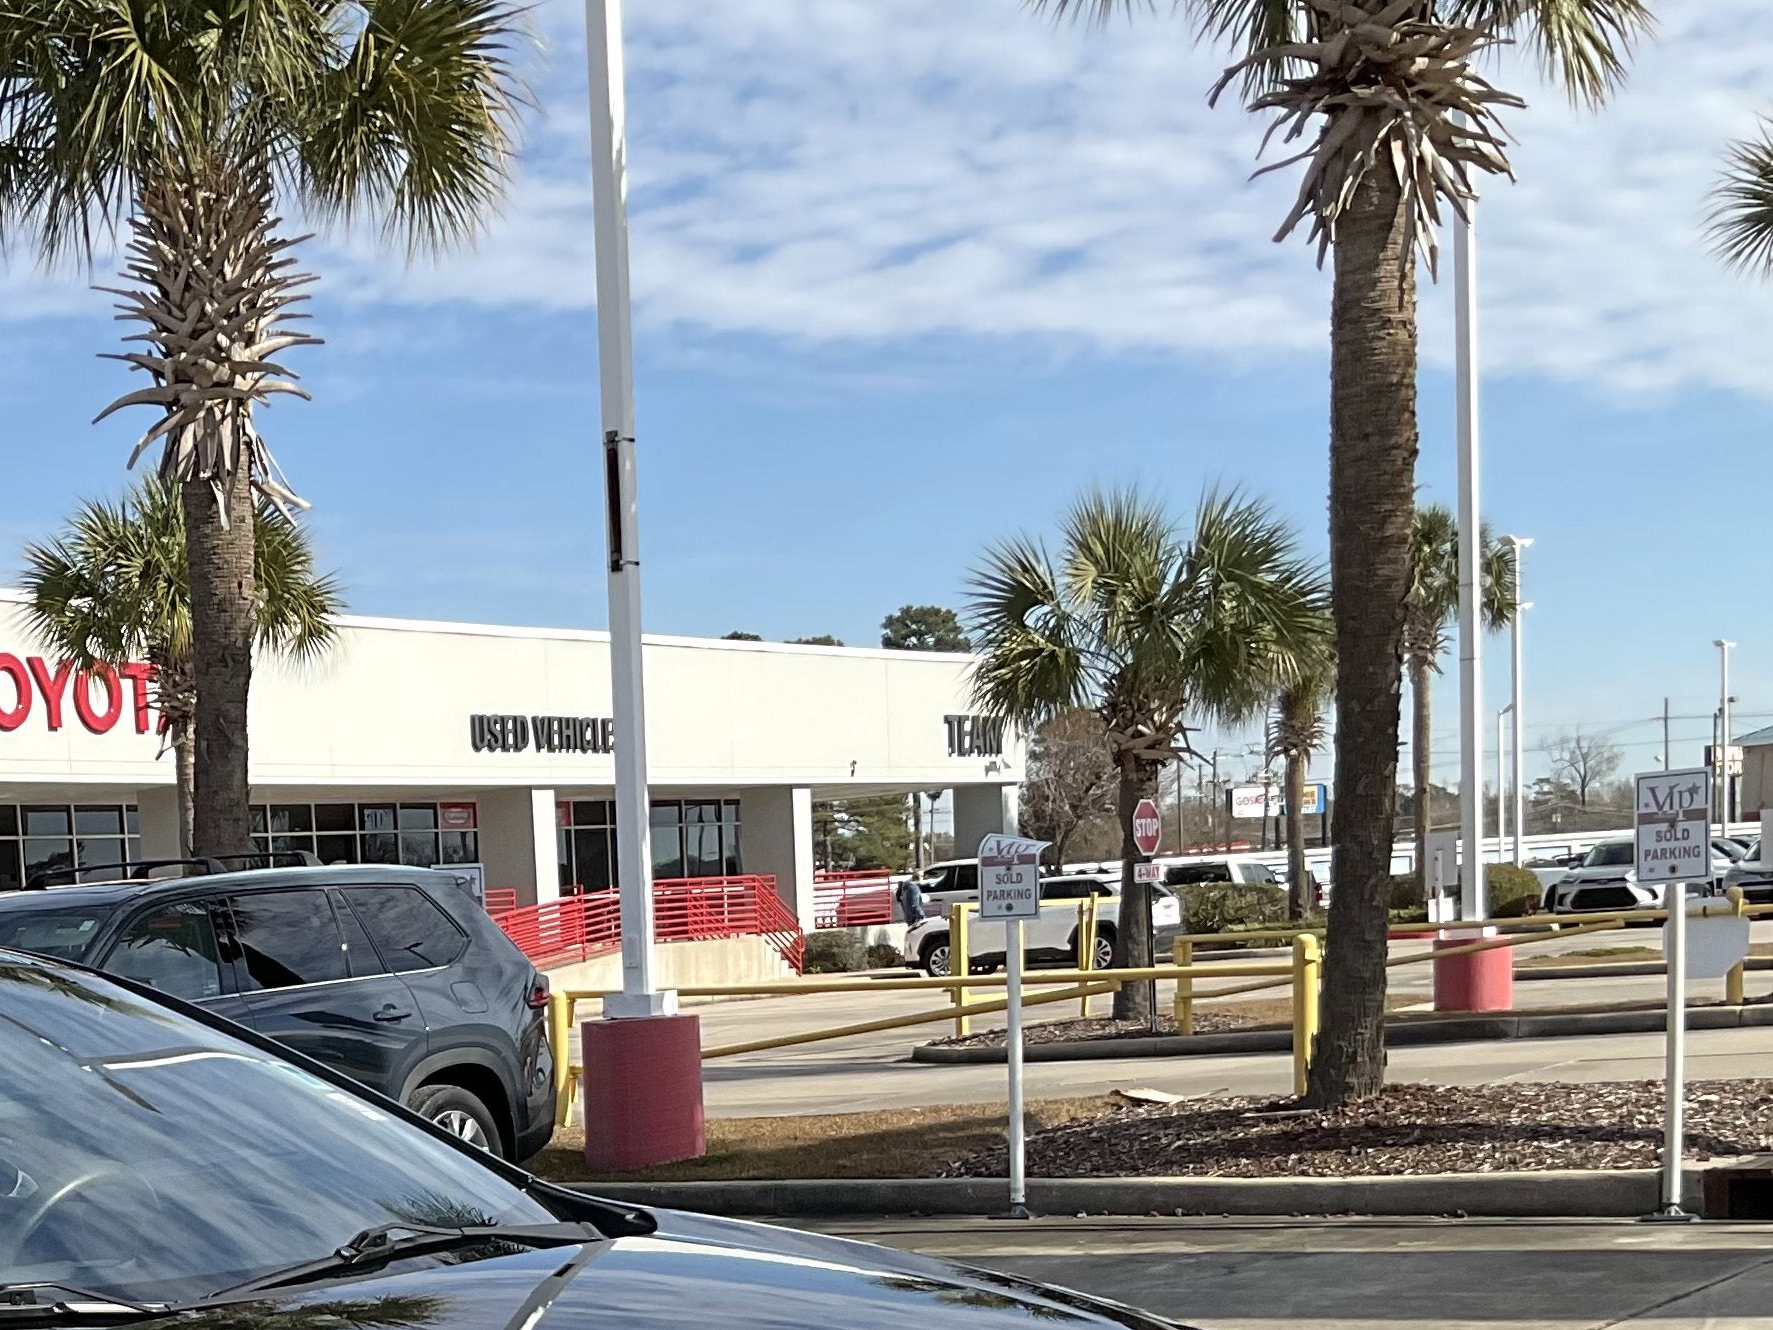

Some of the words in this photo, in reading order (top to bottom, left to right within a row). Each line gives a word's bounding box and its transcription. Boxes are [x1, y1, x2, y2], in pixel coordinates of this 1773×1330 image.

[470, 714, 529, 753] USED
[944, 715, 1003, 757] TEAM
[1135, 818, 1158, 837] STOP
[1655, 828, 1690, 843] SOLD
[1644, 845, 1700, 862] PARKING
[995, 873, 1023, 884] SOLD
[987, 888, 1032, 901] PARKING
